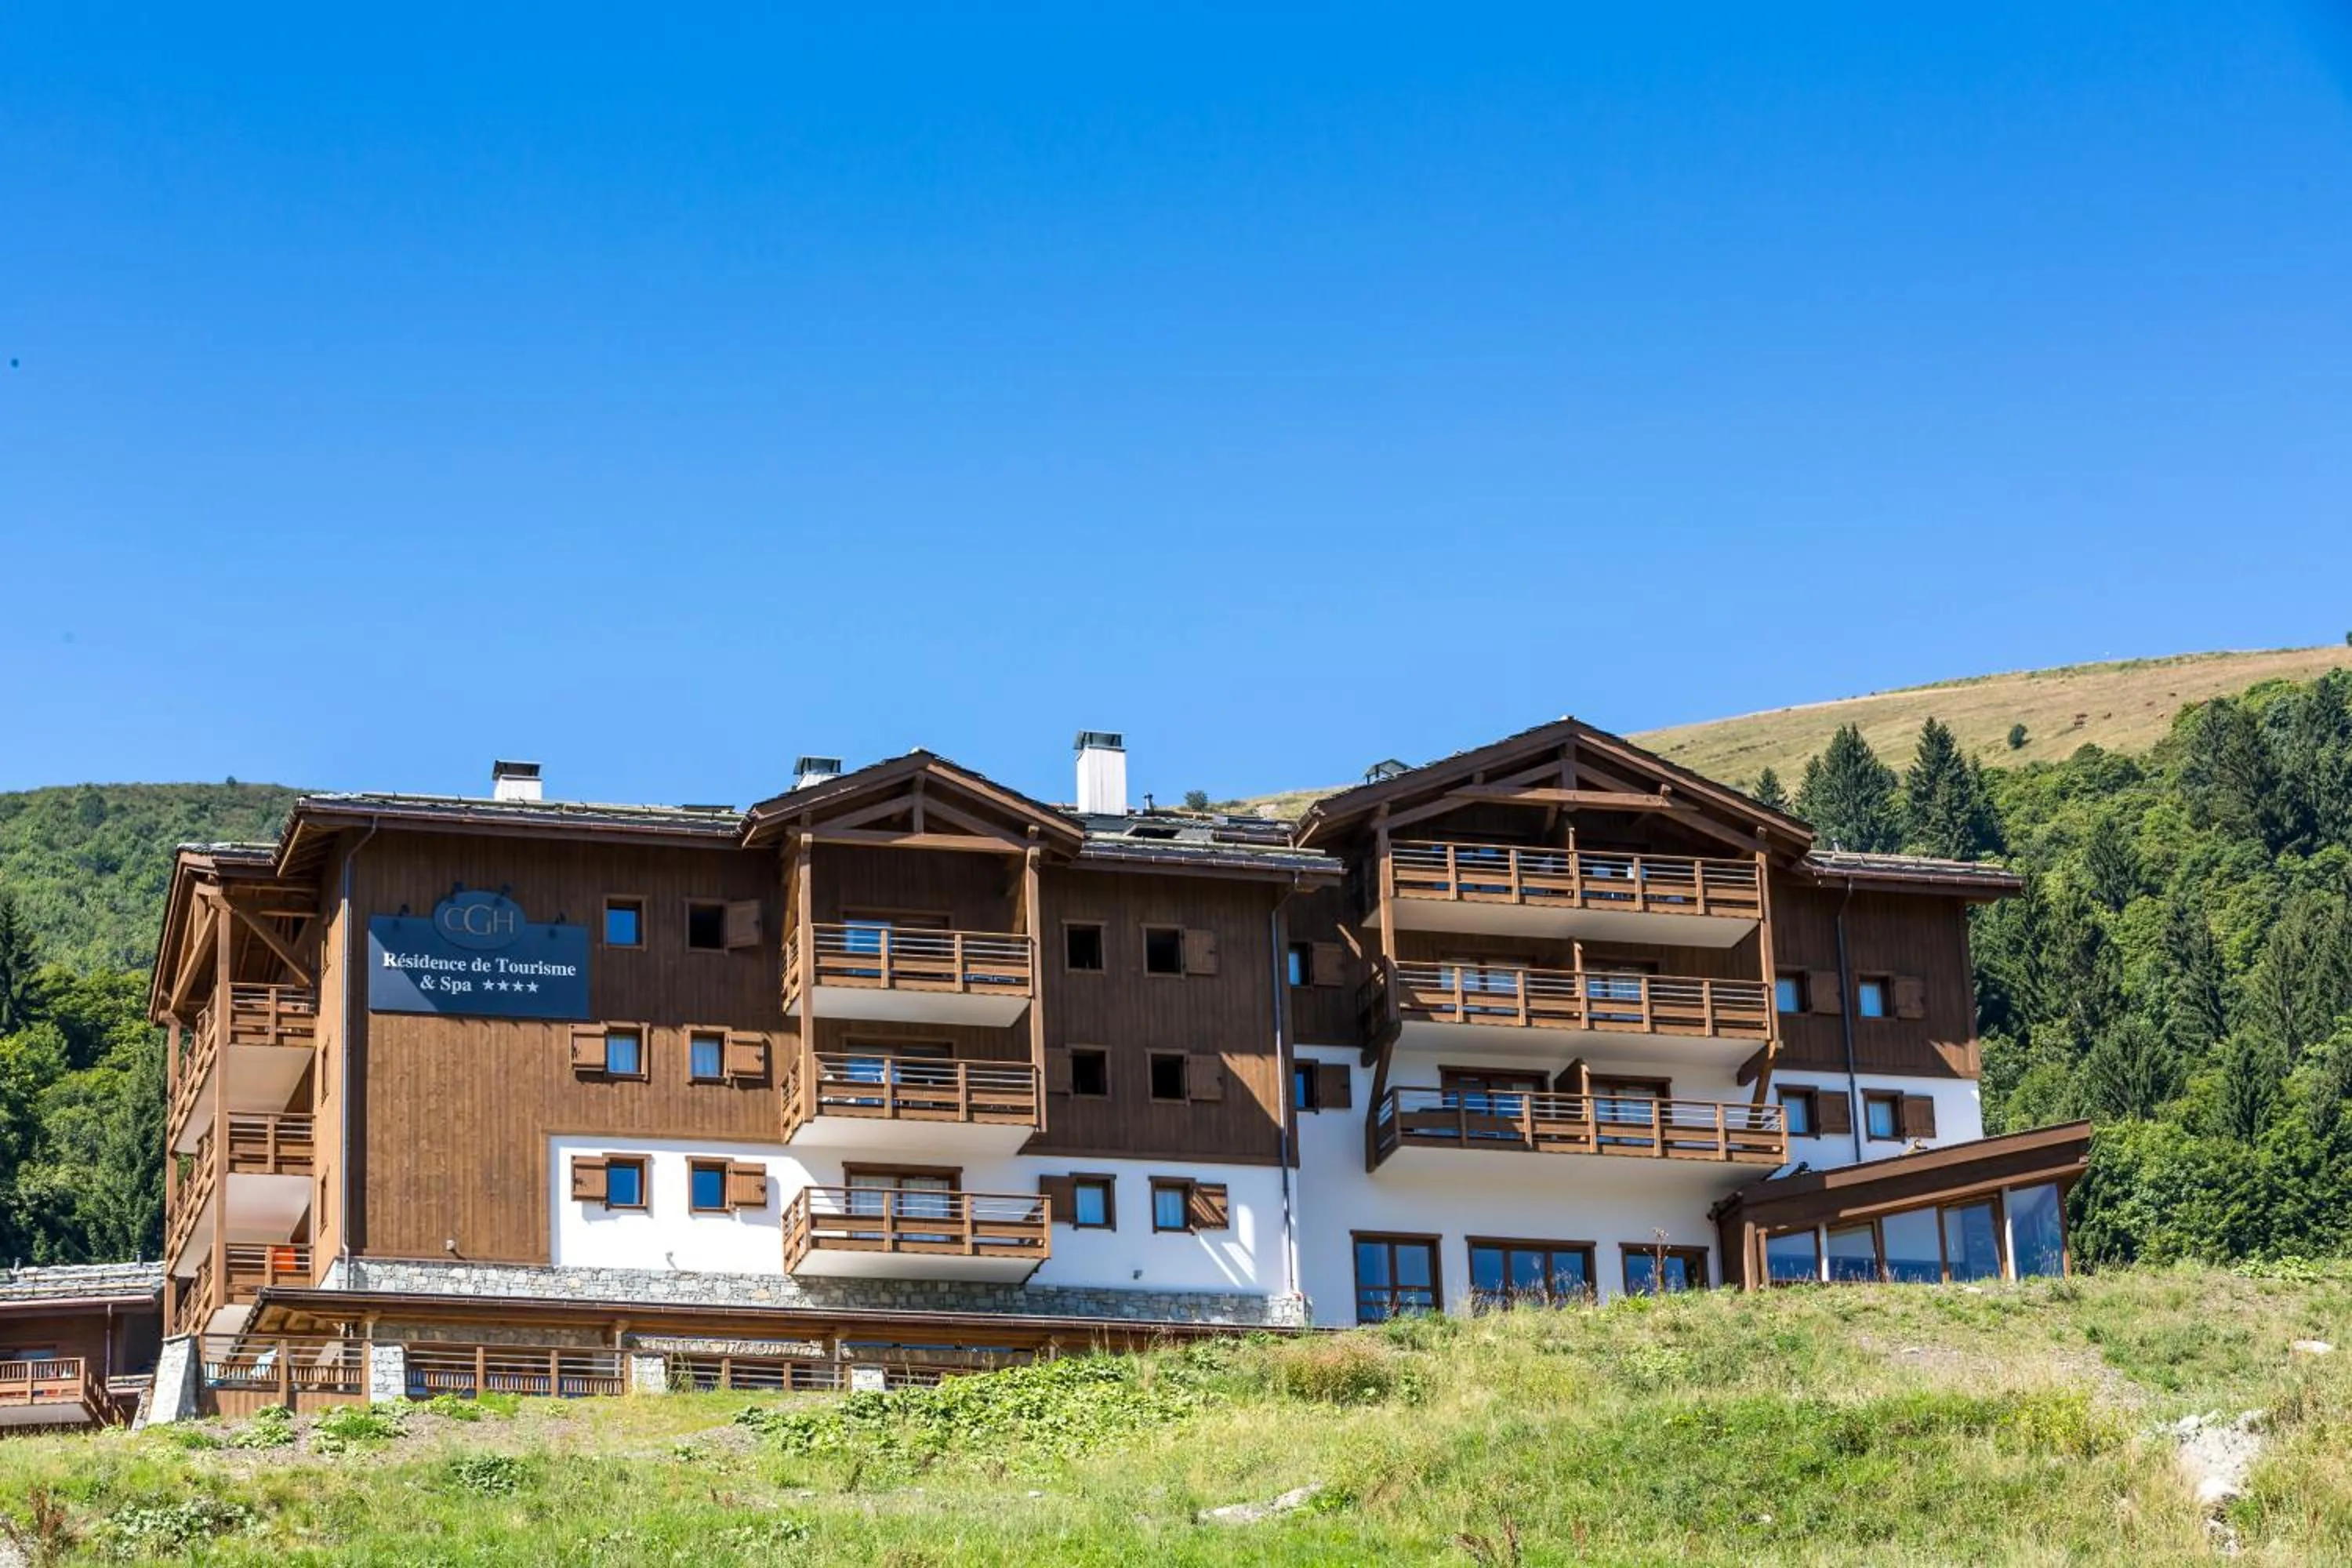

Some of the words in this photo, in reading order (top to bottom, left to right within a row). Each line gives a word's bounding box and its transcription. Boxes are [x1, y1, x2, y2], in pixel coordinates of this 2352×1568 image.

[445, 904, 514, 935] CGH
[383, 952, 466, 971] Résidence
[471, 957, 492, 972] de
[495, 957, 576, 976] Tourisme
[419, 975, 435, 989] &
[440, 976, 472, 994] Spa
